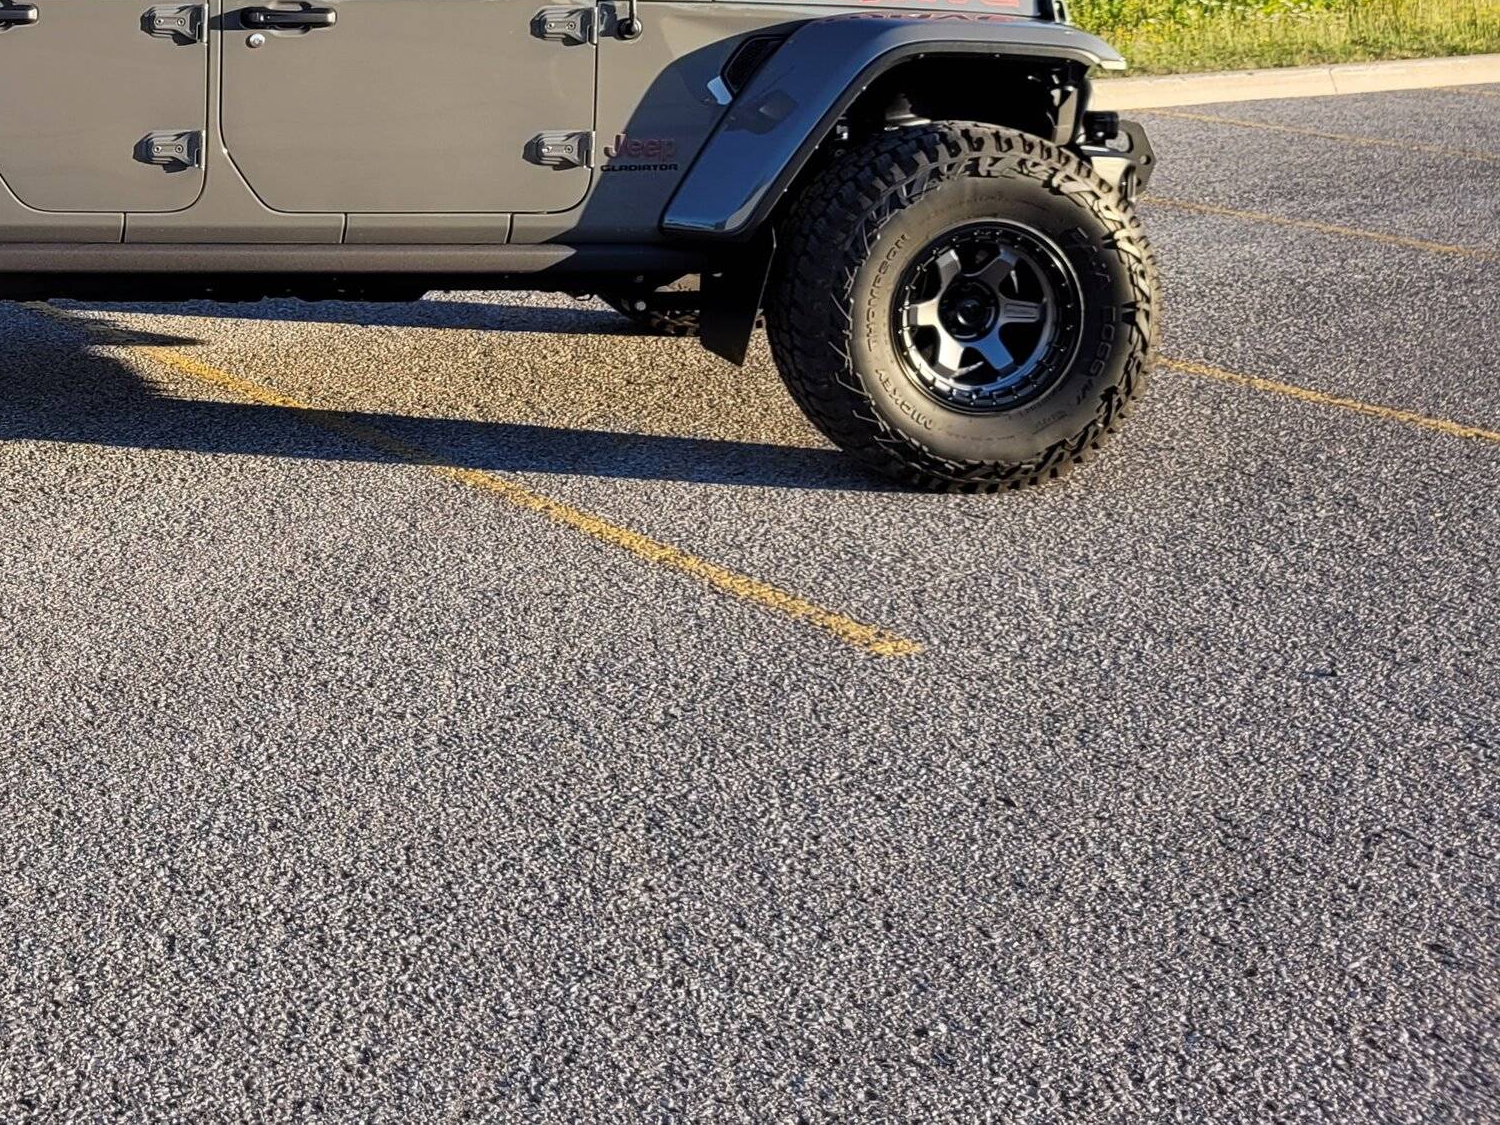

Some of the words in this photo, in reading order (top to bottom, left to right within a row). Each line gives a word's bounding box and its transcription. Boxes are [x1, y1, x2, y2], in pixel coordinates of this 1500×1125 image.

[603, 133, 677, 165] Jeep
[600, 163, 678, 172] GLADIATOR
[865, 233, 908, 353] THOMPSON
